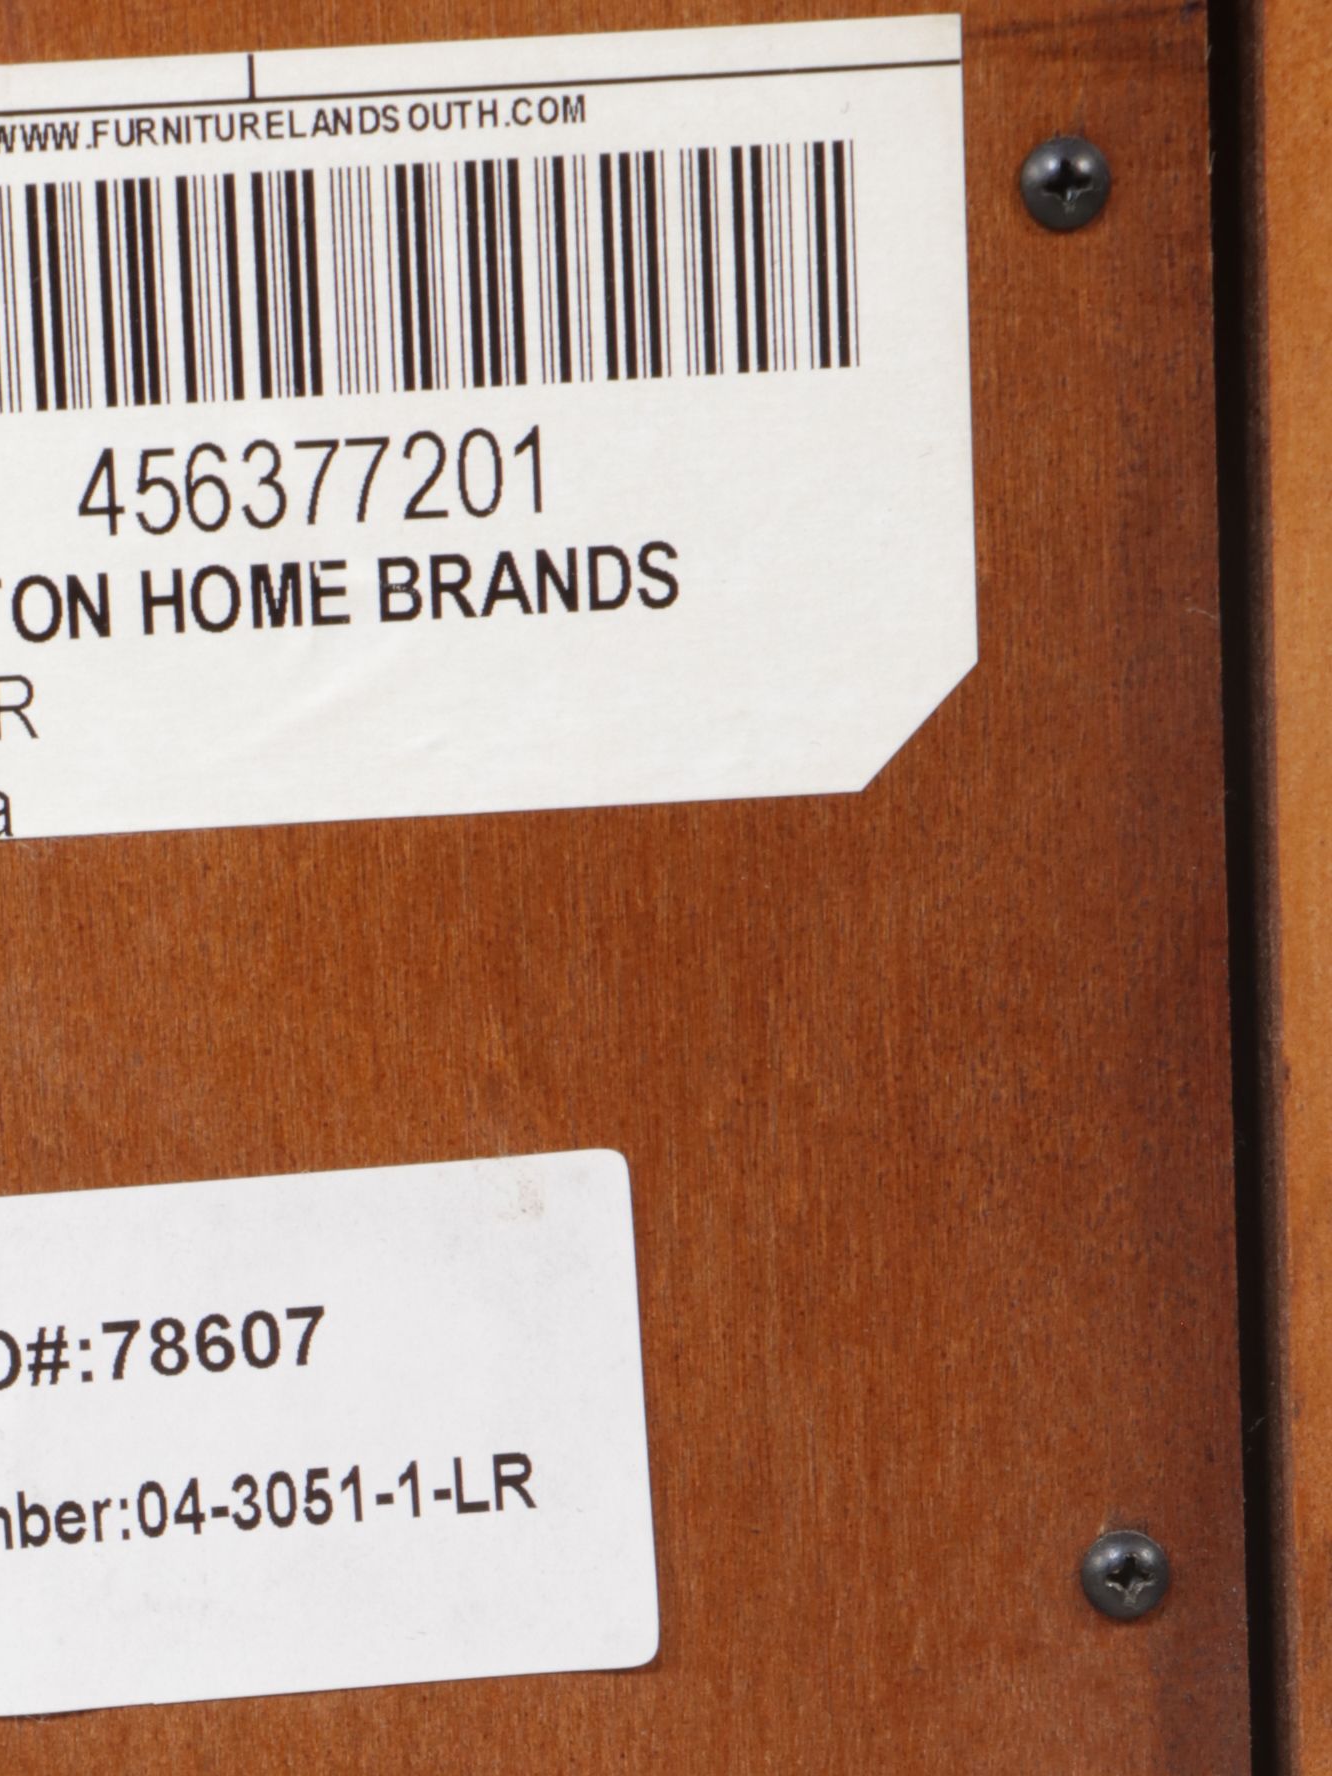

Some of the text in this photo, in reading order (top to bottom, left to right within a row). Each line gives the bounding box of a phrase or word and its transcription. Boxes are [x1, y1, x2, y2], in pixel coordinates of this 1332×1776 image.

[77, 424, 543, 537] 456377201
[140, 559, 351, 636] HOME
[377, 540, 680, 623] BRANDS
